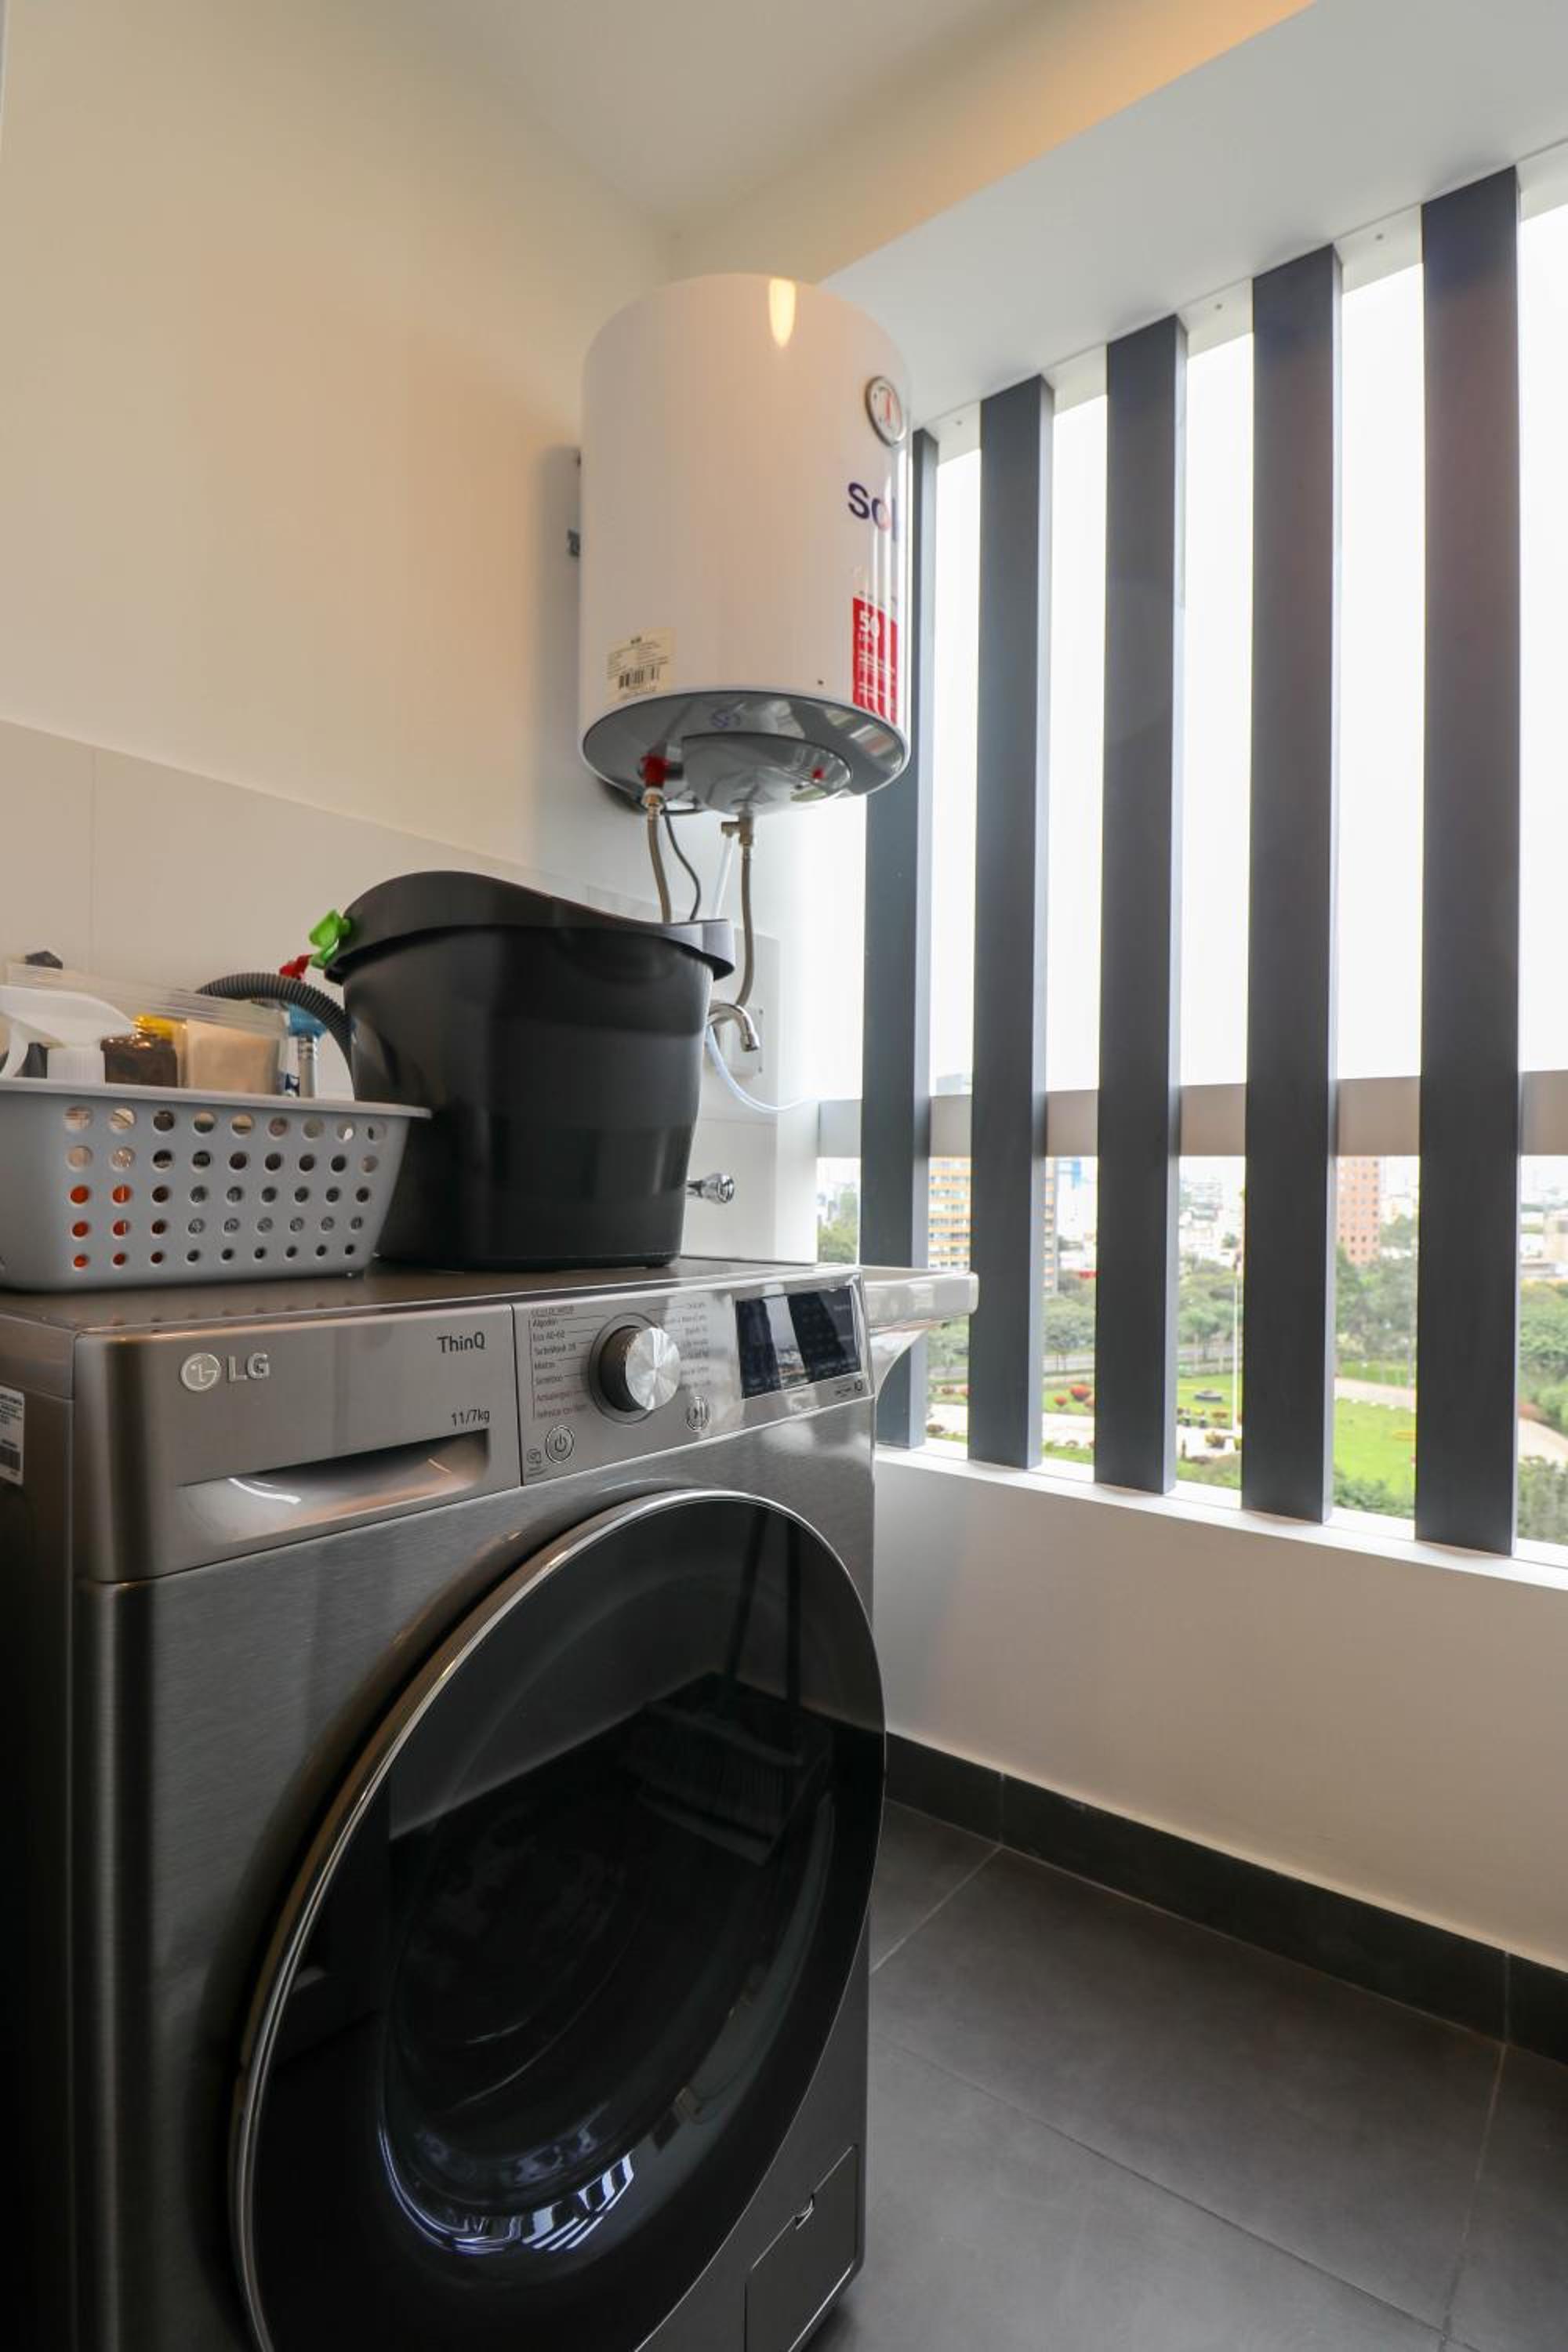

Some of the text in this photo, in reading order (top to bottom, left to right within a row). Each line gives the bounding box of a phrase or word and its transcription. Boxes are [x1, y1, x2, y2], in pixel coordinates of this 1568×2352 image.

[437, 1330, 486, 1354] ThinQ
[227, 1352, 270, 1382] LG
[451, 1409, 490, 1426] 11/7kg
